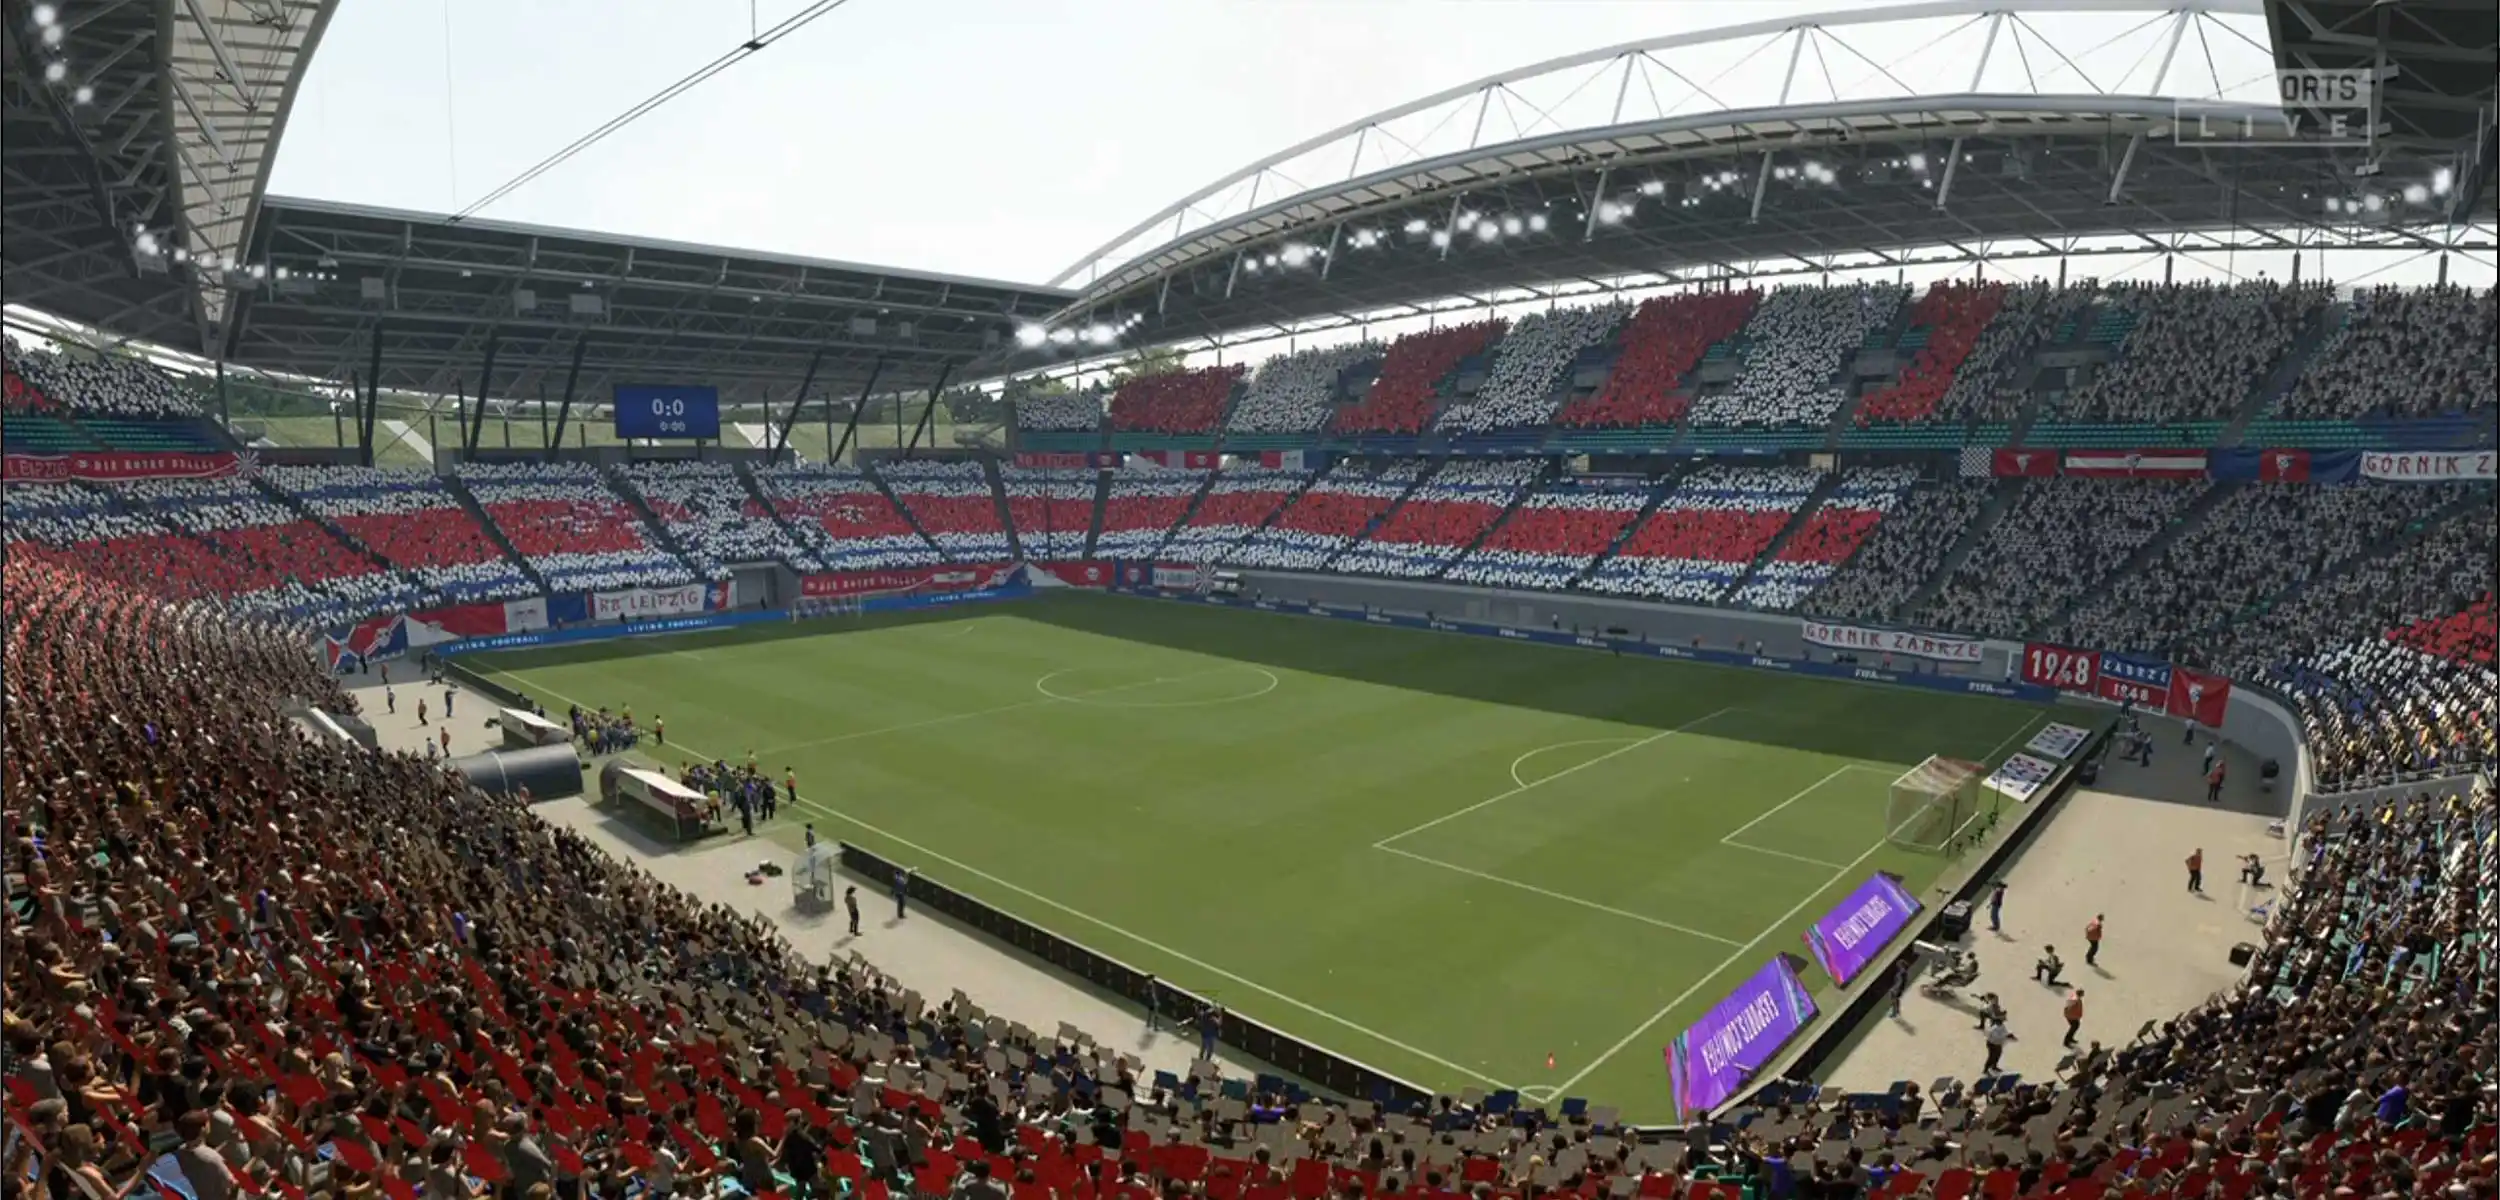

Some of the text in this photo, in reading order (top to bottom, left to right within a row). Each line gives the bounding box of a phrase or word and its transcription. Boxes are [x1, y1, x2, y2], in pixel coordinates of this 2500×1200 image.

[652, 398, 684, 415] 0:0
[8, 459, 69, 477] LEIPZIG
[630, 590, 698, 609] LEIPZIG
[627, 621, 663, 632] LIVING
[449, 640, 486, 652] LIVING
[1894, 633, 1980, 659] ZABRZE
[2031, 649, 2090, 686] 1948
[2103, 659, 2168, 683] ZABRZE
[2113, 682, 2149, 702] 1948
